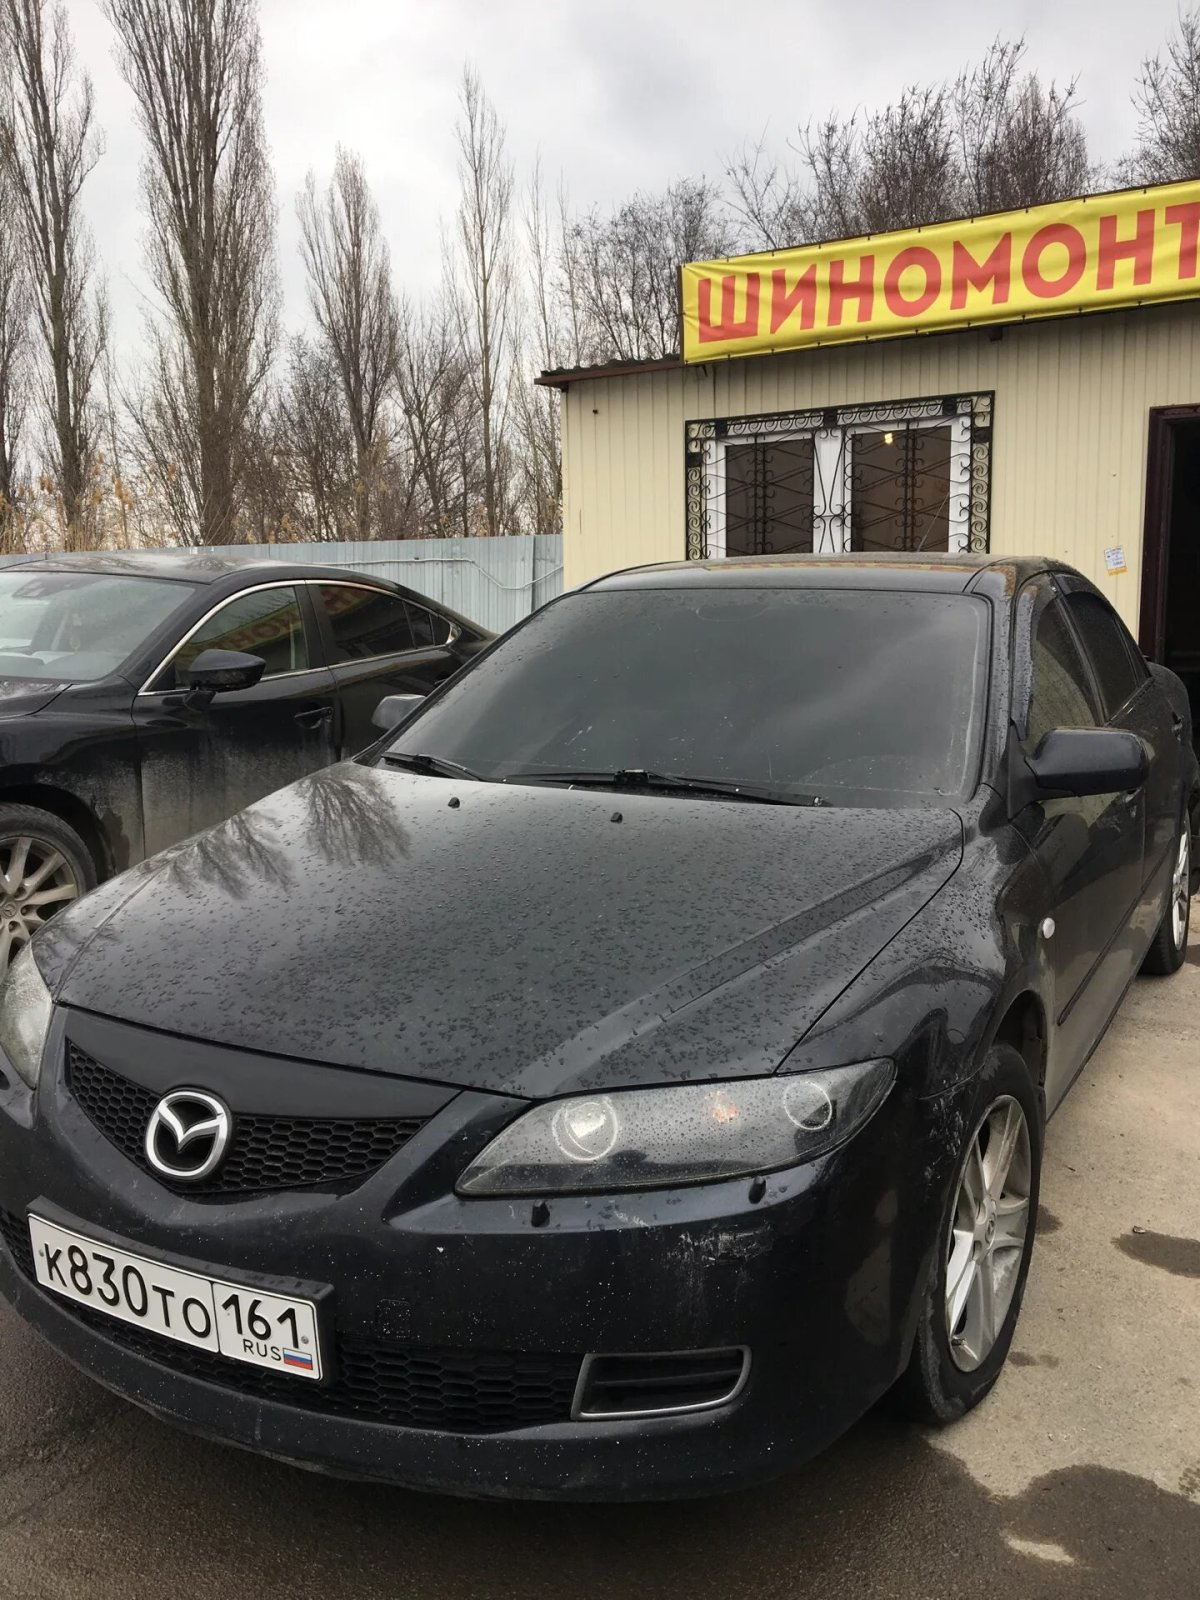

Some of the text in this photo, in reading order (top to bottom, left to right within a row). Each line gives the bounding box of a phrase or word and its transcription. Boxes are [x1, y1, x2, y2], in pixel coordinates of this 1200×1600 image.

[698, 201, 1200, 343] ШИНОМОНТ
[221, 1294, 299, 1349] 161
[242, 1338, 282, 1362] RUS
